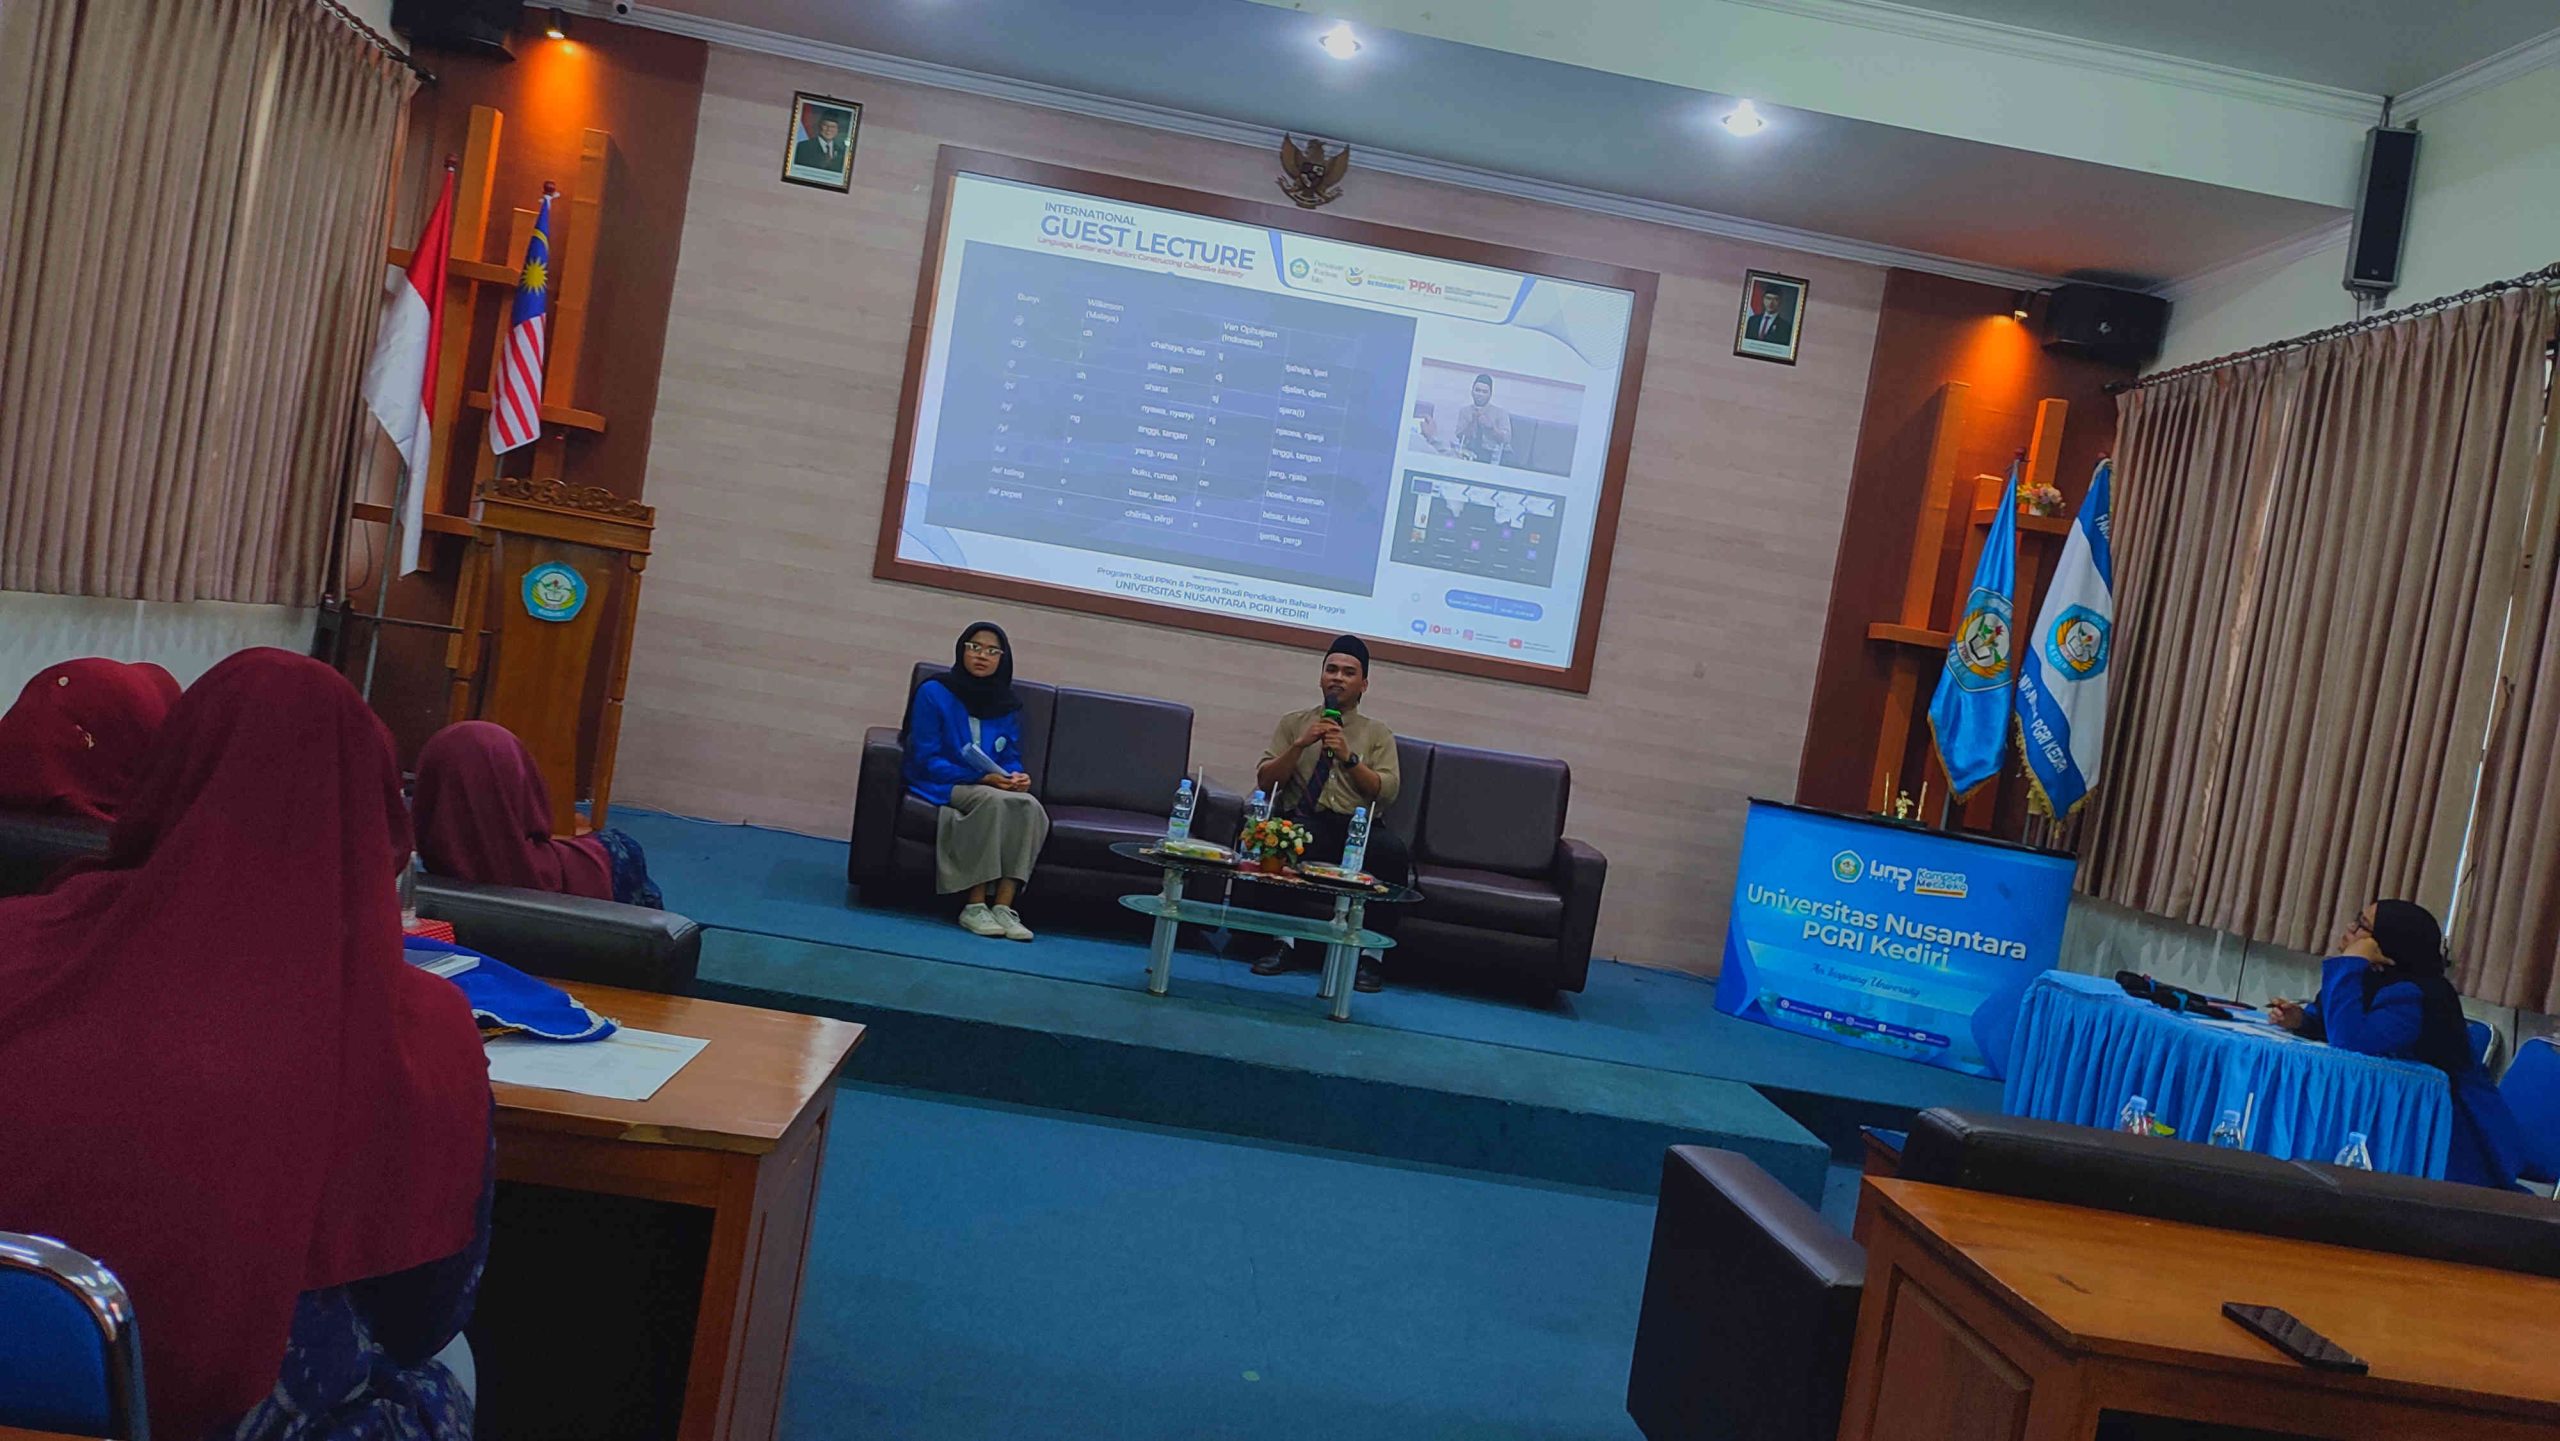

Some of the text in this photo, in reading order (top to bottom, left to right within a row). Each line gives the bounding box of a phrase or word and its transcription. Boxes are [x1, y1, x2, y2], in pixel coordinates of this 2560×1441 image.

[1044, 201, 1136, 226] INTERNATIONAL
[1040, 215, 1256, 270] GUEST LECTURE
[1408, 277, 1442, 296] PPKn
[1223, 321, 1239, 332] Van
[1096, 566, 1132, 582] Program
[1133, 572, 1155, 584] Studi
[1155, 576, 1178, 588] PPKn
[1185, 580, 1221, 596] Program
[1222, 586, 1243, 597] Studi
[1243, 590, 1288, 606] Pendidikan
[1289, 597, 1318, 611] Bahasa
[1318, 603, 1346, 616] Inggris
[1115, 580, 1183, 600] UNIVERSITAS
[1183, 590, 1247, 611] NUSANTARA
[1249, 601, 1274, 615] PGRI
[1275, 605, 1310, 621] KEDIRI
[2030, 718, 2052, 745] PGRI
[1916, 878, 1967, 892] Merdeka
[1918, 869, 1965, 883] Kampus
[1748, 883, 2028, 960] Universitas Nusantara
[1802, 920, 1950, 970] PGRI Kediri
